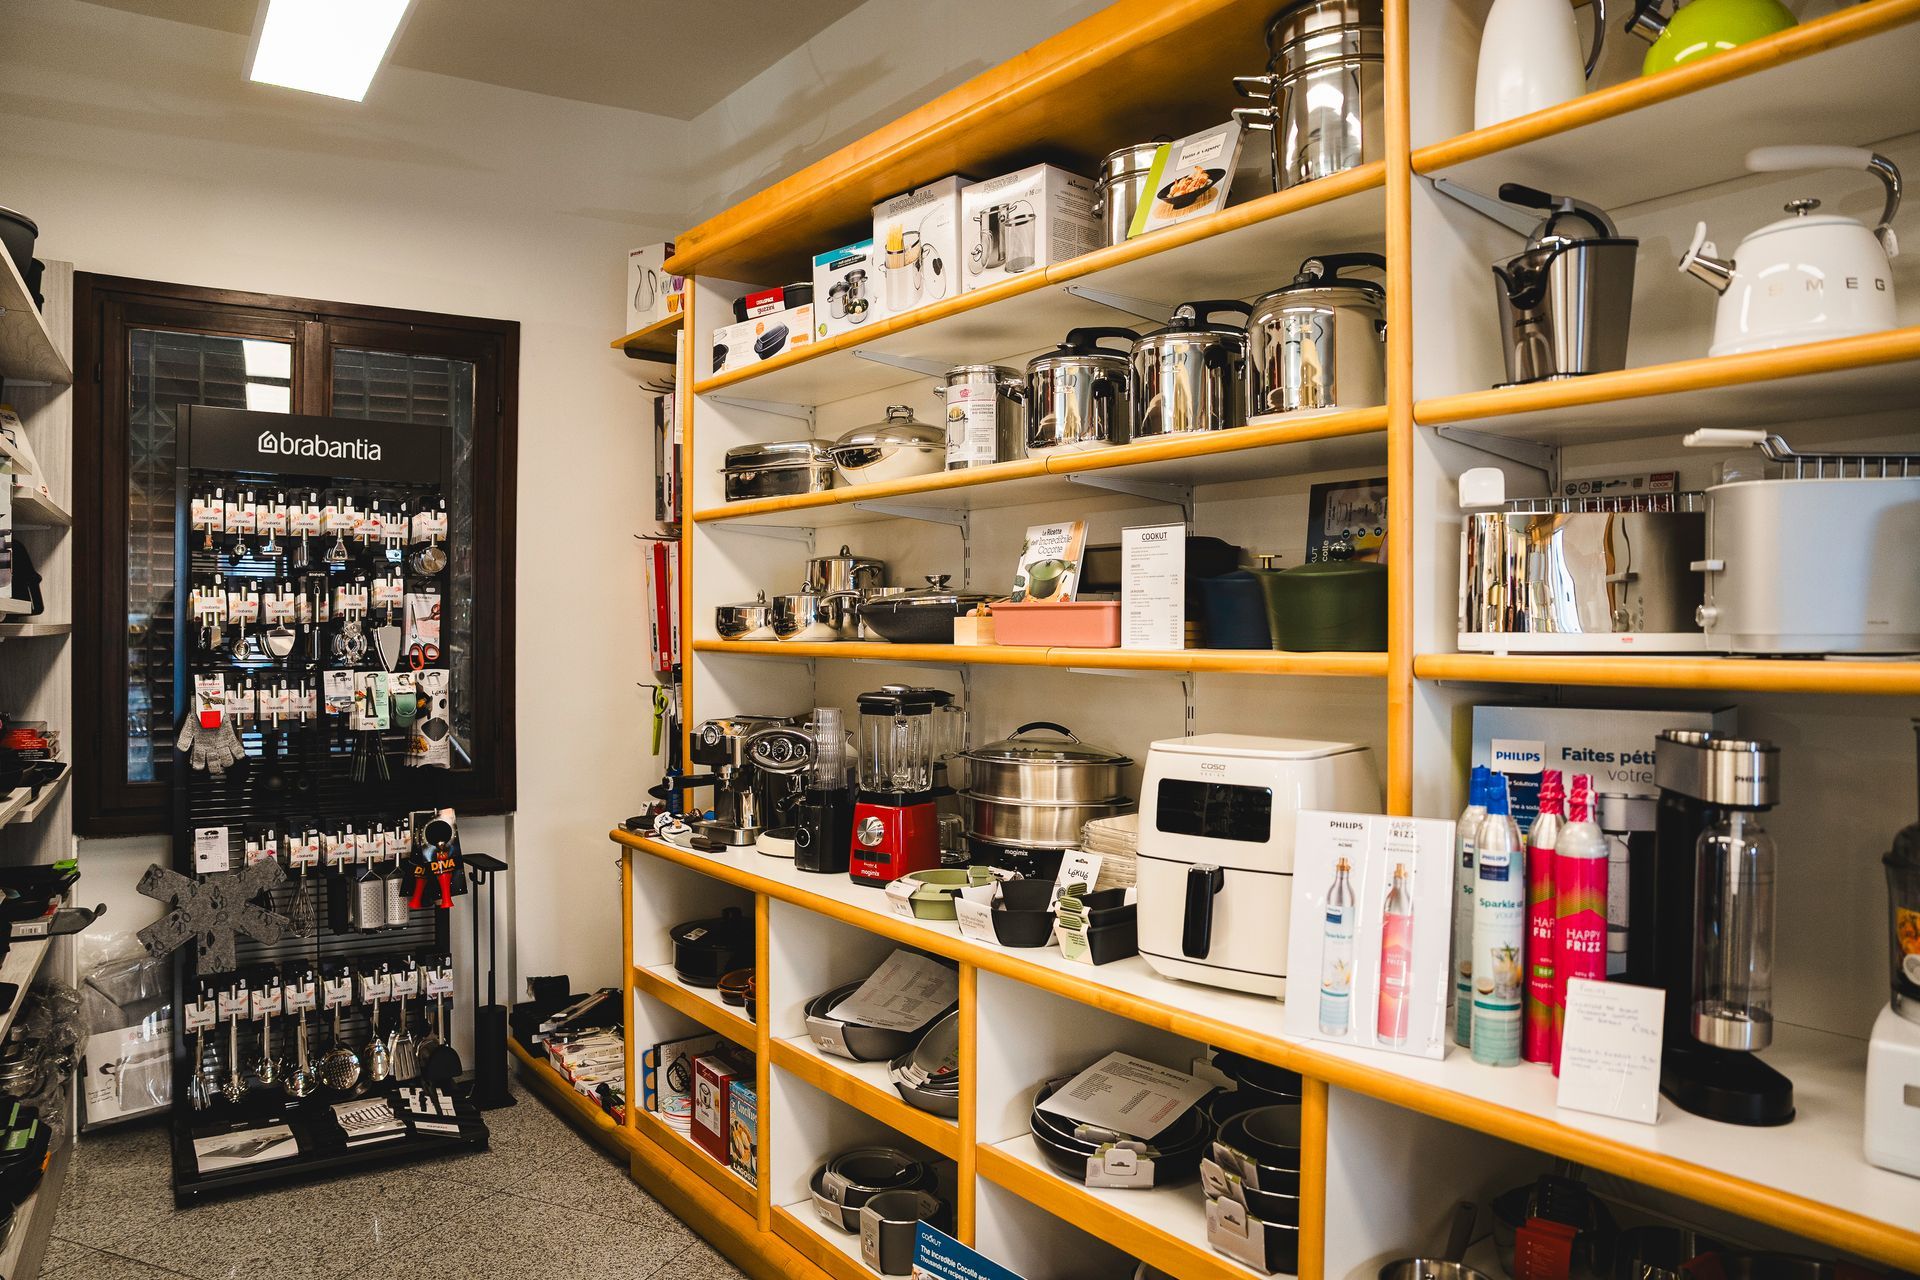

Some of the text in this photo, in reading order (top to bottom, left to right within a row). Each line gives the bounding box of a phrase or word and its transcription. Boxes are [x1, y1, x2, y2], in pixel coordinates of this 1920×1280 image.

[280, 430, 382, 461] brabantia
[1141, 531, 1168, 541] COOKUT
[1496, 750, 1541, 763] PHILIPS
[1561, 746, 1656, 767] Faites péti
[1607, 769, 1653, 784] votre
[1330, 820, 1363, 830] PHILIPS
[1004, 848, 1029, 857] magimix
[431, 858, 456, 871] DIVA
[1479, 897, 1516, 909] Sparkle
[1533, 926, 1554, 939] FRI
[1566, 927, 1600, 941] HAPPY
[1566, 939, 1601, 953] FRIZZ
[920, 1244, 931, 1256] The
[931, 1249, 957, 1268] Incredible
[956, 1262, 978, 1279] Cocotte
[920, 1254, 943, 1271] Thousands
